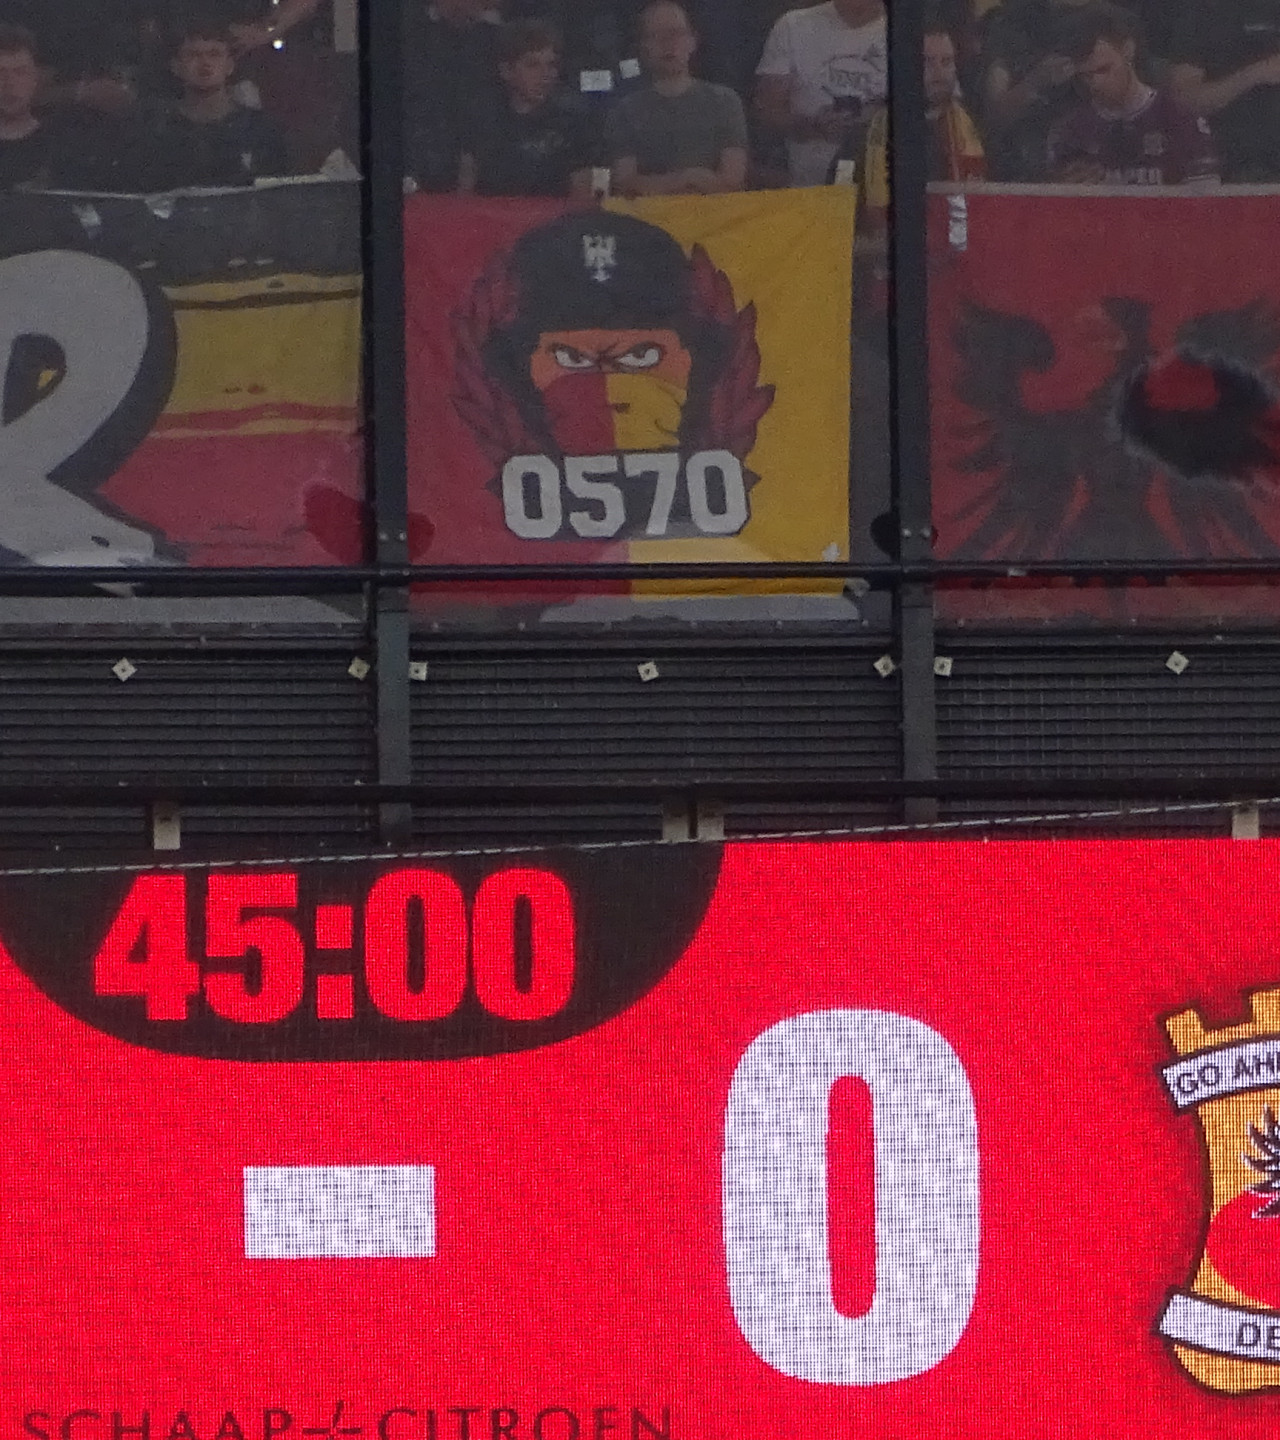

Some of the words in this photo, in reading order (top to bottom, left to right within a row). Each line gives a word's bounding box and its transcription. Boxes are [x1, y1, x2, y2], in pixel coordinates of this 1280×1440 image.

[502, 449, 748, 538] 0570
[92, 868, 576, 1023] 45:00
[1176, 1065, 1220, 1094] GO
[723, 1008, 980, 1386] 0
